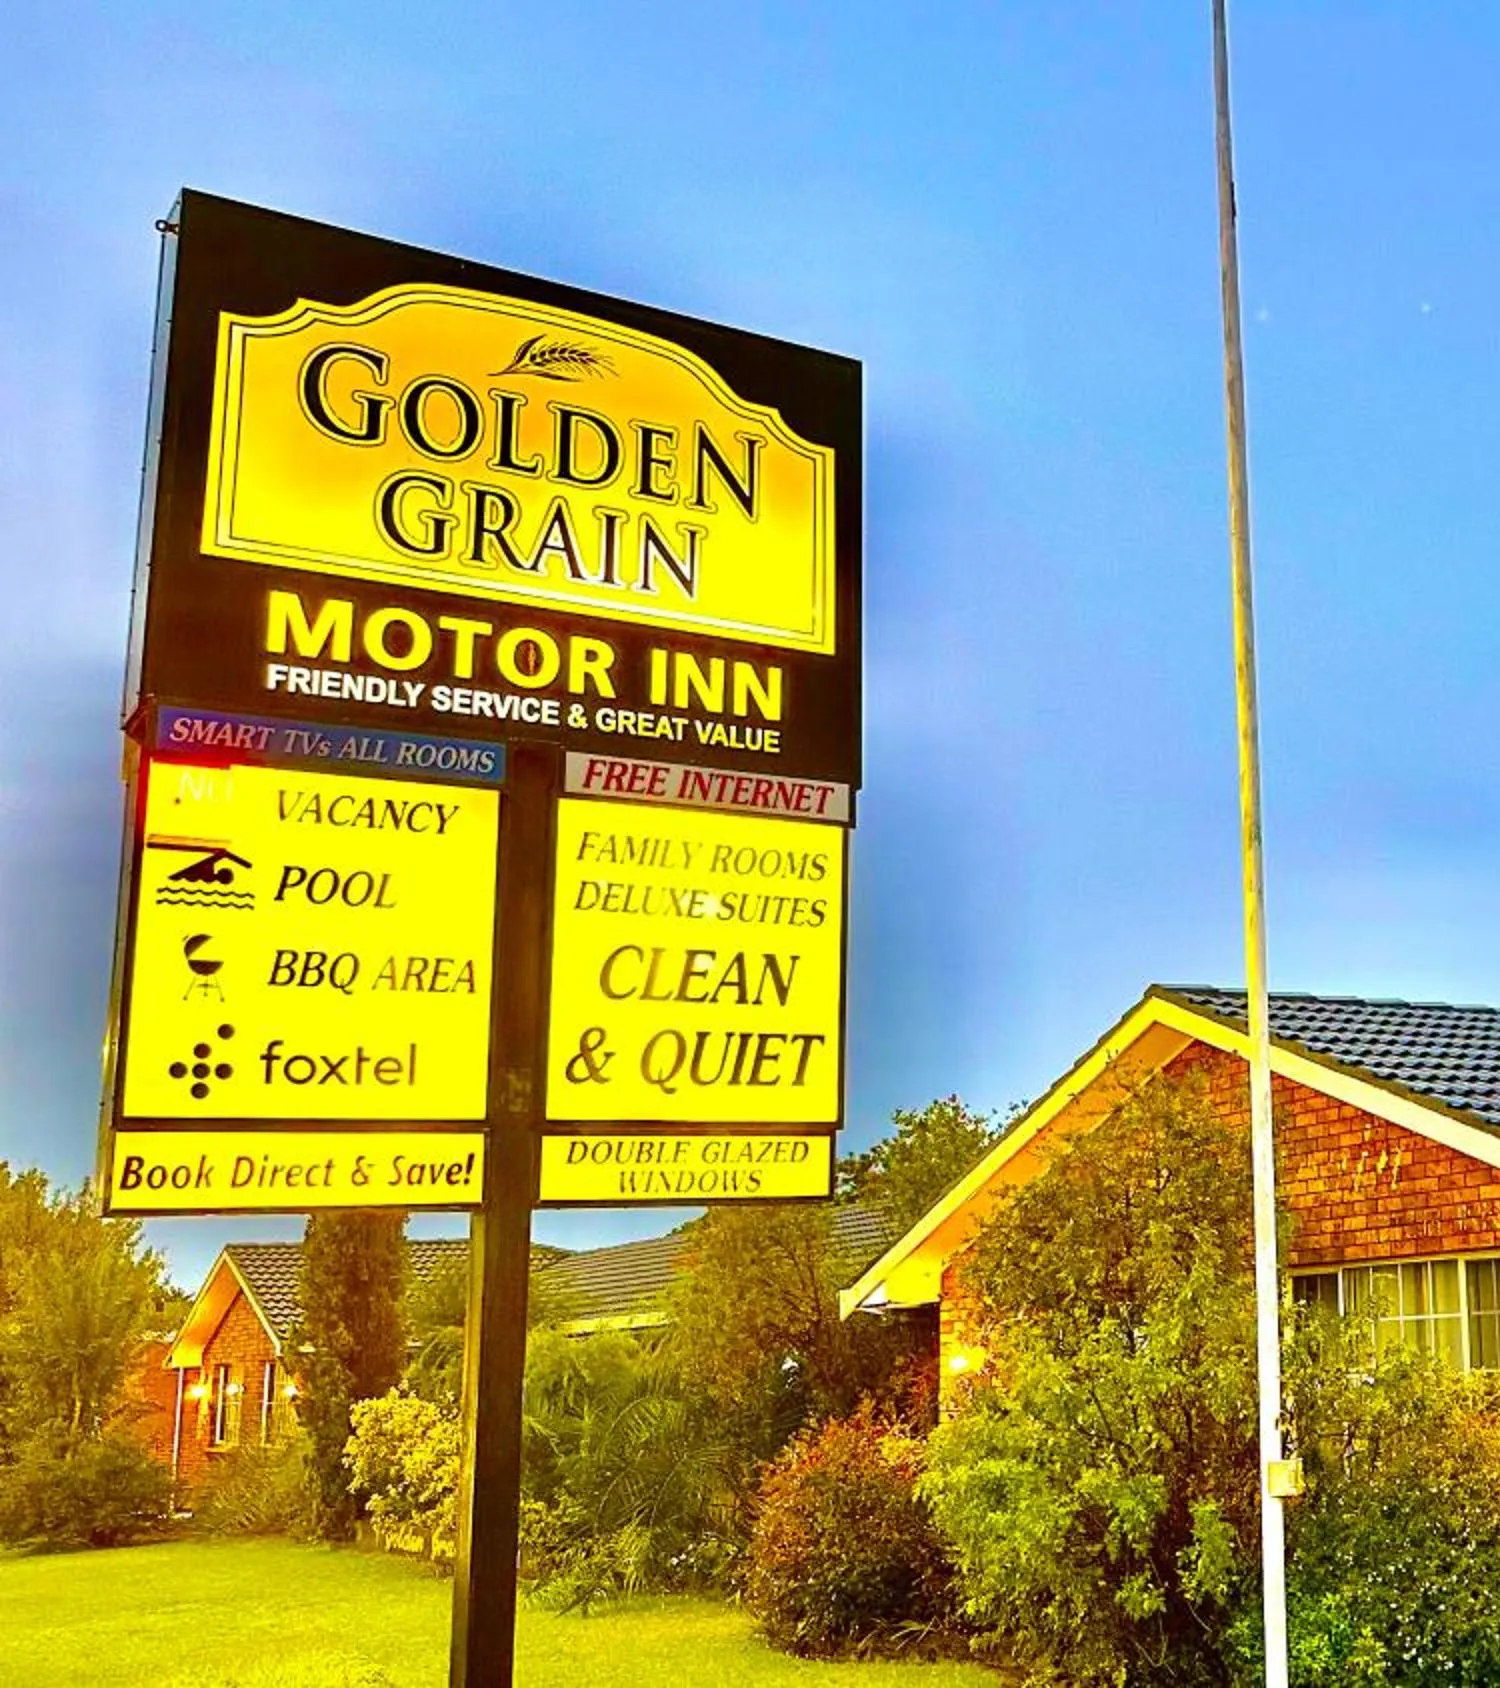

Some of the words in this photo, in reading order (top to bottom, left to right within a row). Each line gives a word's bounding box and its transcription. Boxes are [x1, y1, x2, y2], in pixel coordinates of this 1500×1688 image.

[301, 342, 766, 521] GOLDEN
[375, 469, 706, 602] GRAIN
[265, 589, 618, 700] MOTOR
[650, 647, 783, 722] INN
[266, 664, 424, 708] FRIENDLY
[431, 685, 560, 726] SERVICE
[567, 703, 588, 730] &
[595, 707, 690, 742] GREAT
[695, 720, 781, 754] VALUE
[168, 717, 276, 752] SMART
[283, 729, 330, 758] TVs
[337, 735, 389, 765] ALL
[395, 742, 497, 774] ROOMS
[277, 788, 460, 835] VACANCY
[582, 759, 670, 797] FREE
[677, 769, 835, 815] INTERNET
[576, 831, 704, 871] FAMILY
[709, 844, 829, 882] ROOMS
[273, 865, 397, 910] POOL
[573, 880, 709, 919] DELUXE
[716, 892, 828, 928] SUITES
[267, 949, 361, 996] BBQ
[371, 956, 478, 995] AREA
[599, 945, 800, 1007] CLEAN
[260, 1040, 417, 1087] foxtel
[564, 1026, 616, 1085] &
[639, 1029, 825, 1095] QUIET
[119, 1154, 214, 1191] Book
[231, 1154, 336, 1189] Direct
[350, 1155, 376, 1187] &
[387, 1153, 476, 1187] Save!
[567, 1140, 690, 1166] DOUBLE
[701, 1140, 810, 1165] GLAZED
[618, 1169, 763, 1195] WINDOWS
